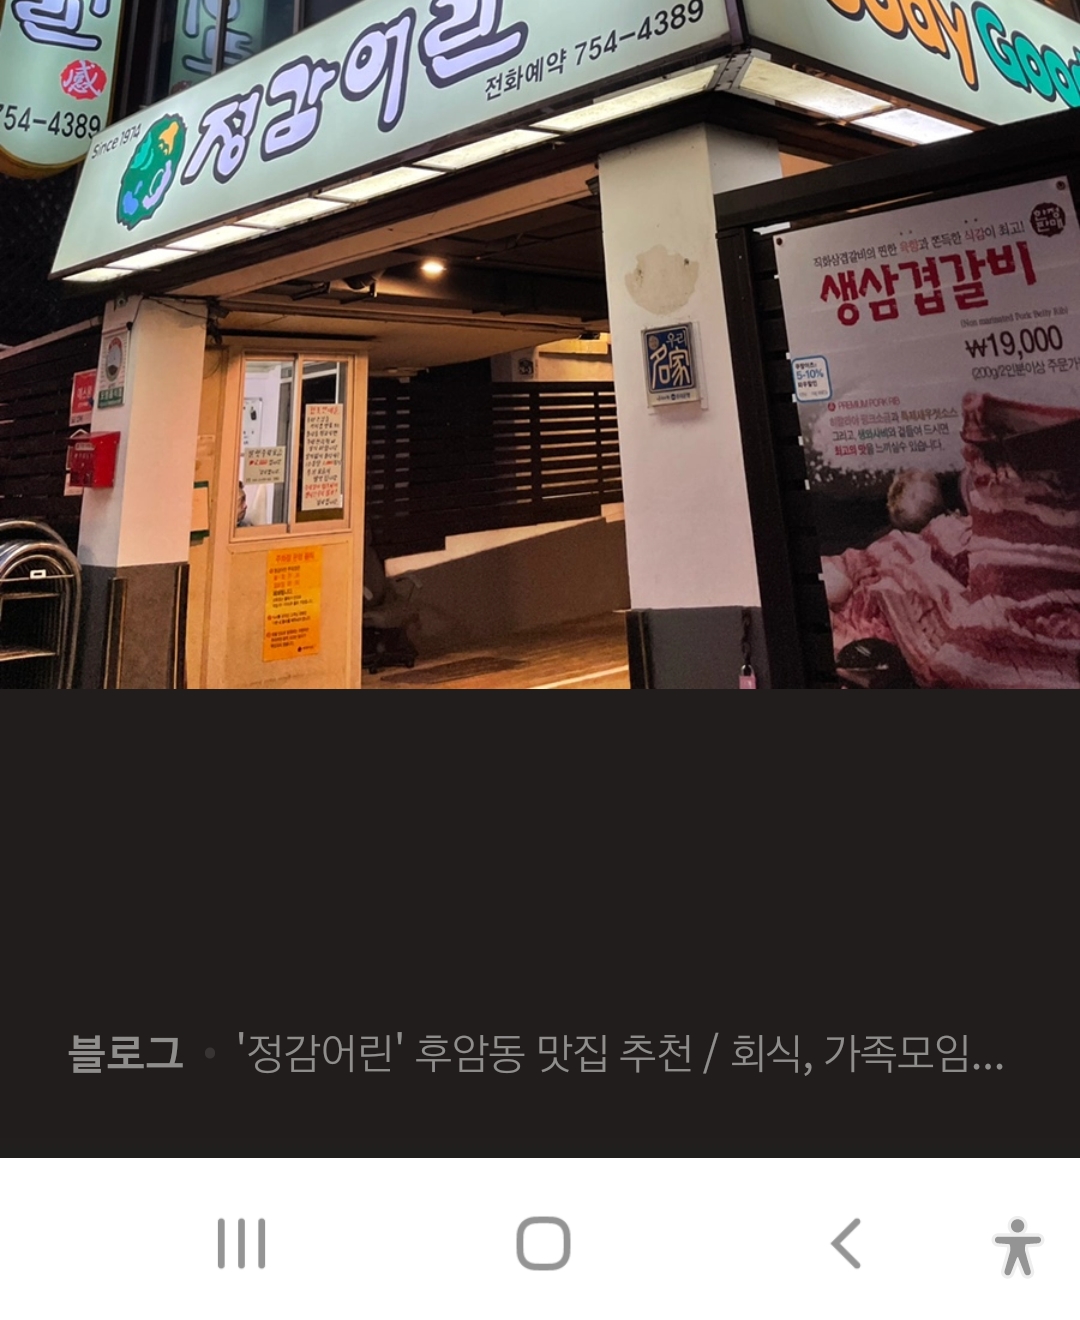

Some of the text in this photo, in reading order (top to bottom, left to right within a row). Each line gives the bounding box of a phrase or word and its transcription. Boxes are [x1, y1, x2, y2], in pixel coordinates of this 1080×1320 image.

[485, 48, 567, 101] 전화예약
[92, 123, 142, 159] Since 1974
[813, 247, 876, 268] 직화삼겹갈비의
[999, 220, 1025, 236] 최고!
[820, 240, 1036, 326] 생삼겹갈비
[965, 325, 1063, 360] ₩19,000
[1047, 356, 1080, 372] 주문가
